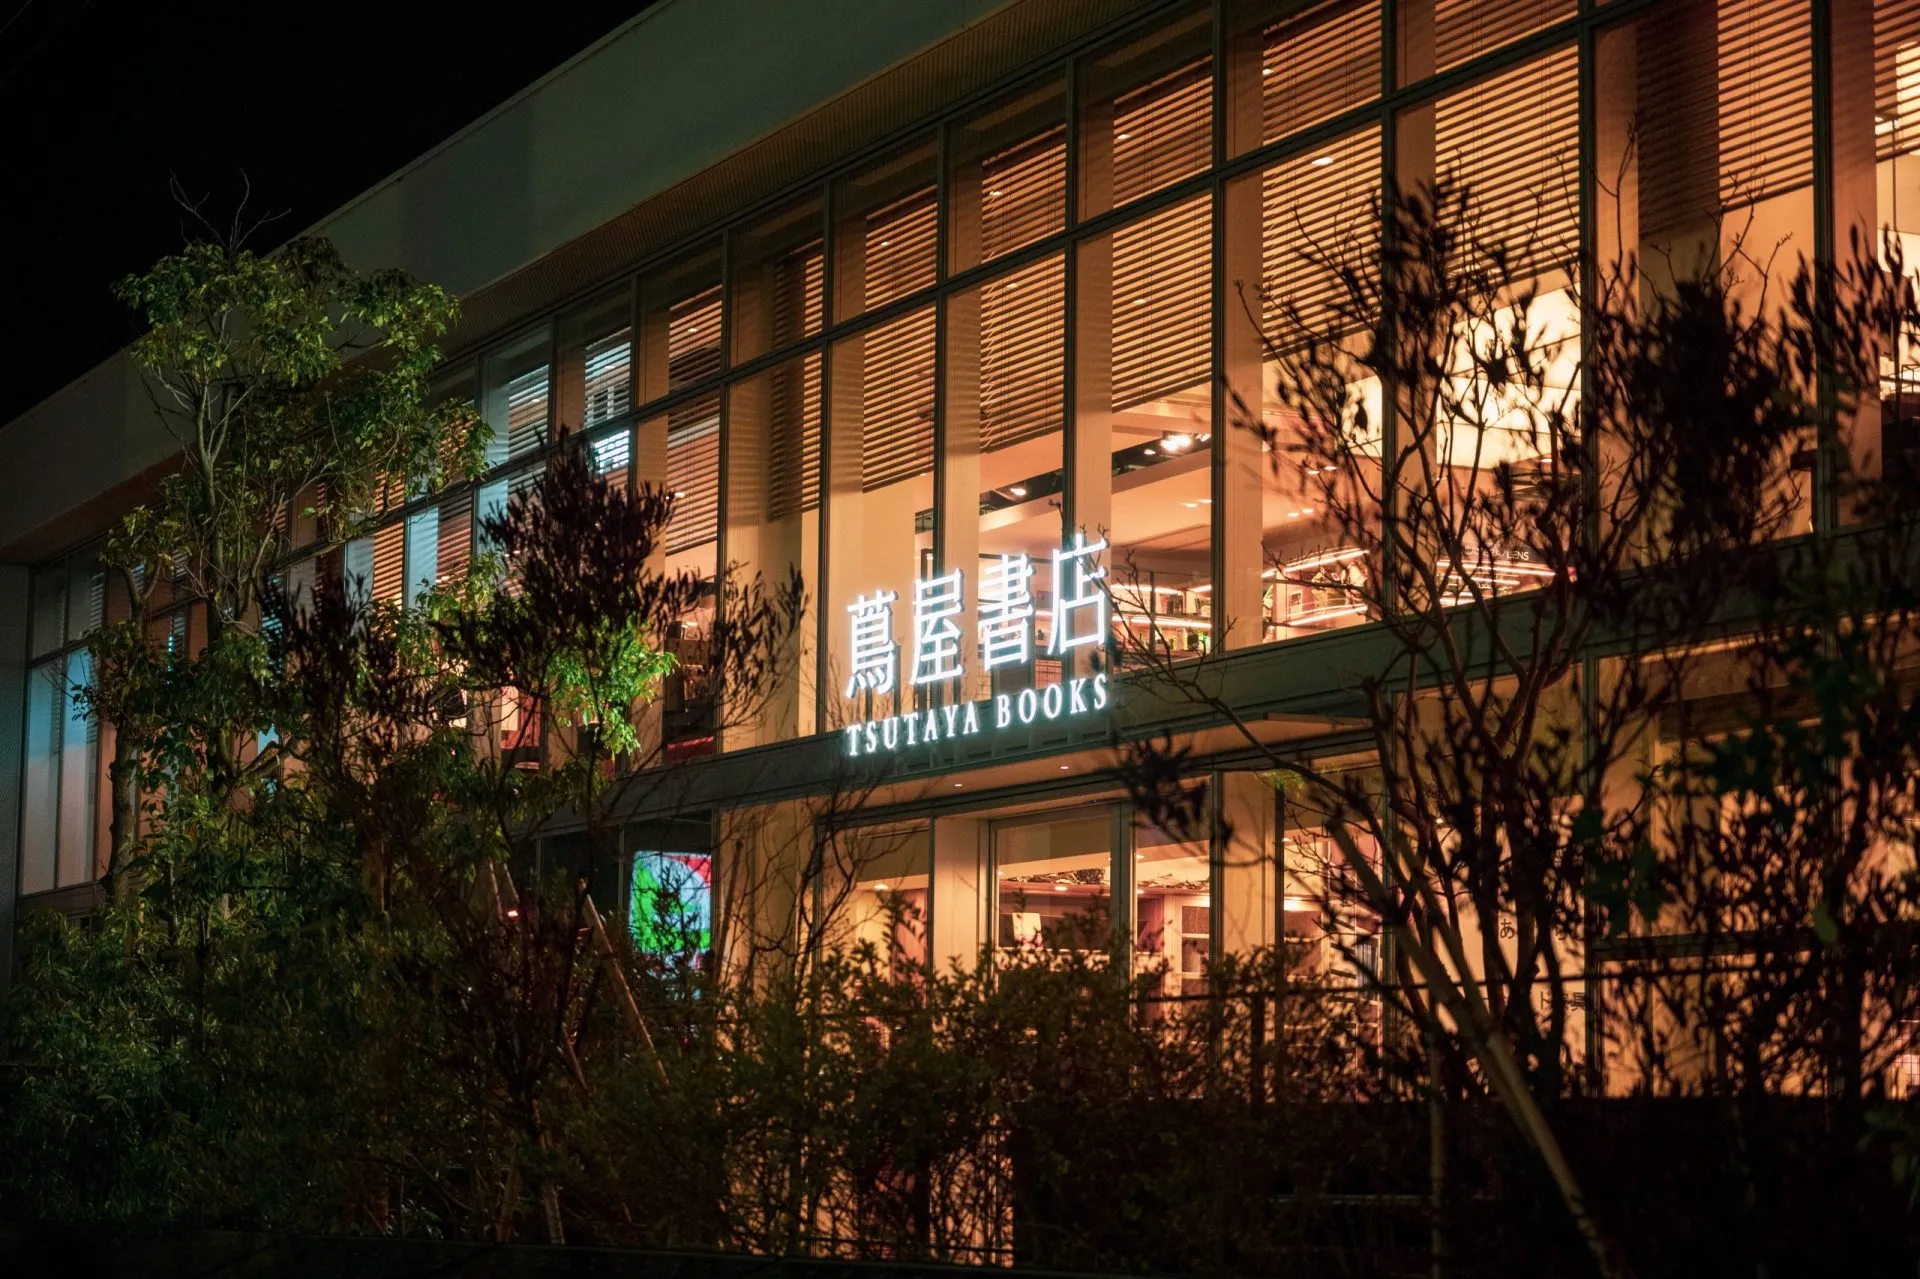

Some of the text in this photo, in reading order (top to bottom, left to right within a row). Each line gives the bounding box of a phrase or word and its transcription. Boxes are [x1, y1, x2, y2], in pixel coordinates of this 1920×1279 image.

[846, 533, 1109, 699] 蔦屋書店
[846, 674, 1109, 757] TSUTAYA BOOKS
